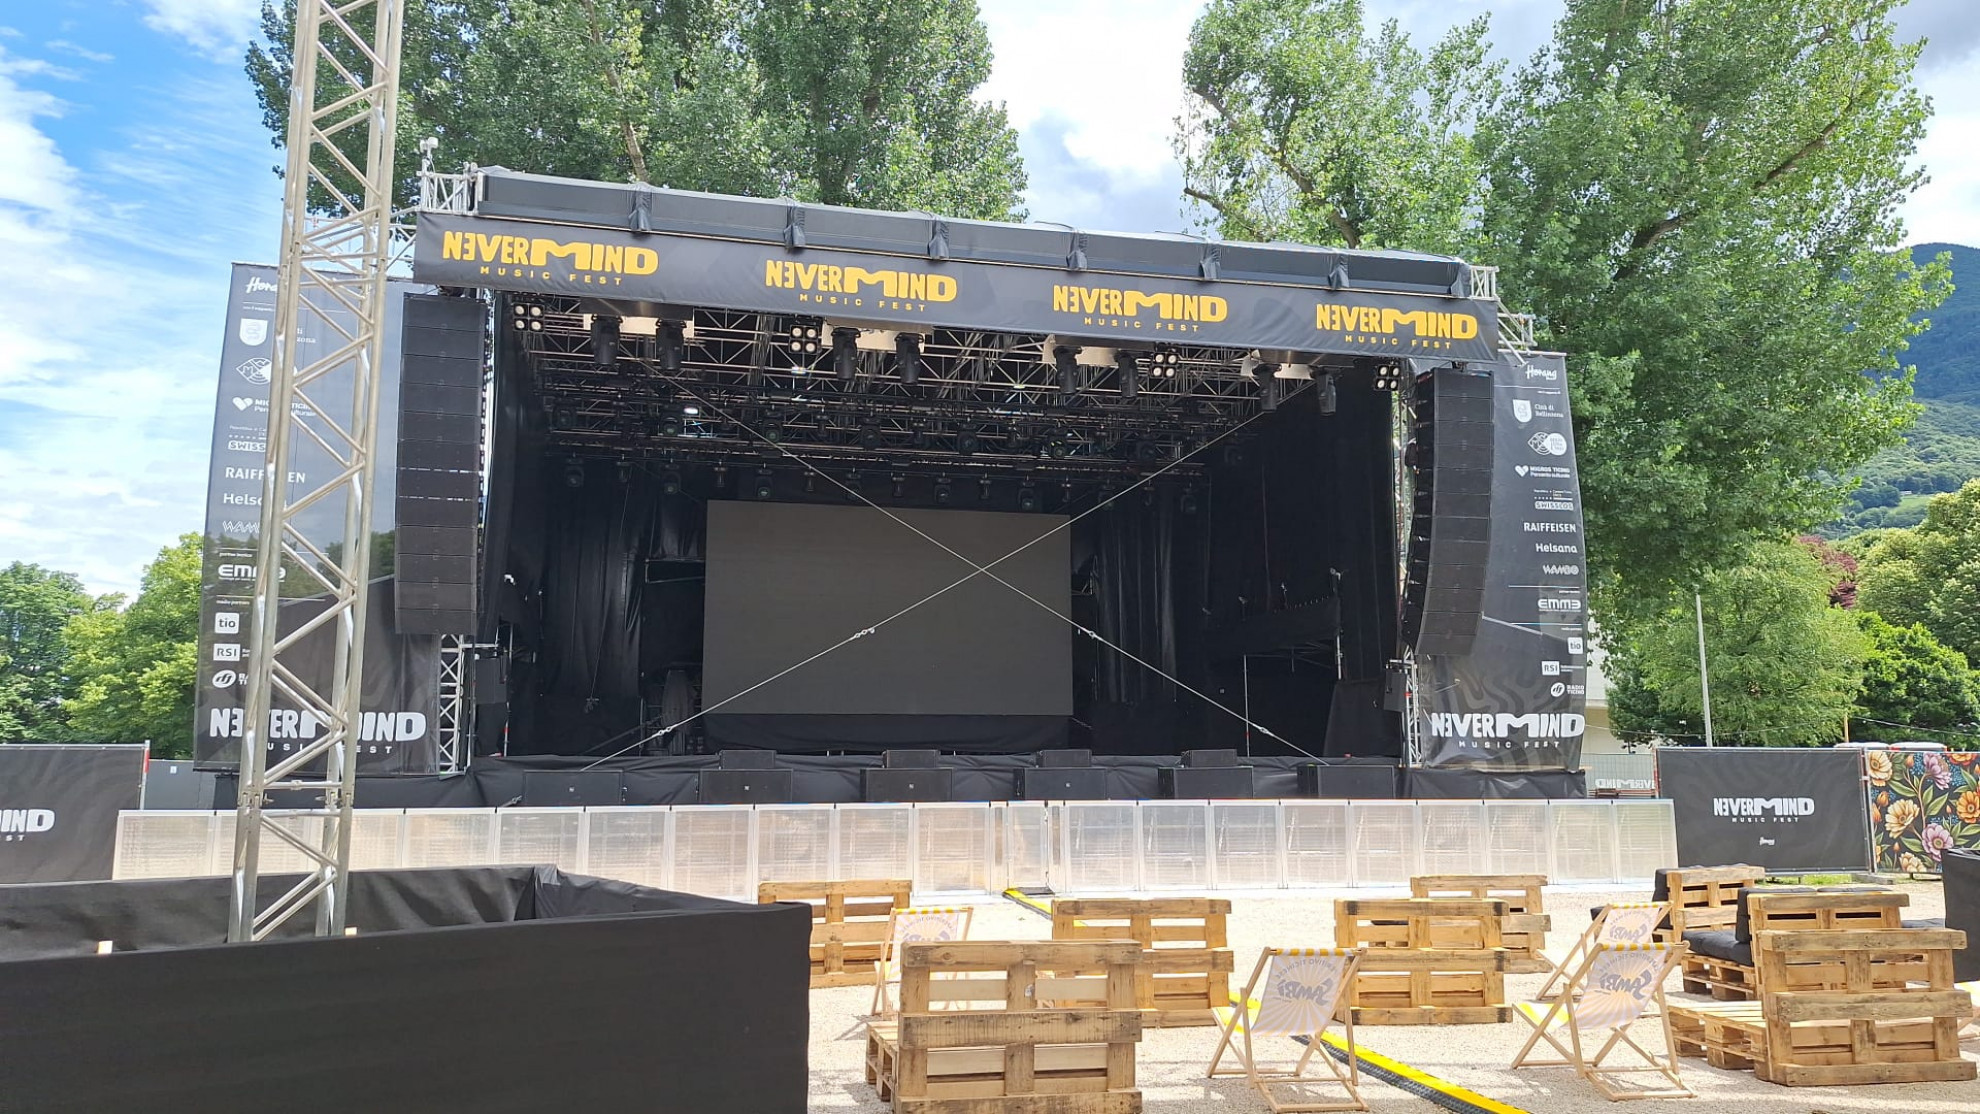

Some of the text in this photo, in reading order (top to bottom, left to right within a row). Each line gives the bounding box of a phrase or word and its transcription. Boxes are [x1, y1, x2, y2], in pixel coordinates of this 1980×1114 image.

[443, 231, 659, 276] NEVERMIND
[480, 266, 622, 285] MUSIC FEST
[766, 261, 958, 302] NEVERMIND
[799, 294, 926, 312] MUSIC FEST
[1053, 285, 1228, 322] NEVERMIND
[1084, 317, 1199, 332] MUSIC FEST
[1316, 304, 1478, 340] NEVERMIND
[1345, 334, 1451, 349] MUSIC FEST
[225, 467, 306, 483] RAIFFEN
[1523, 522, 1577, 533] RAIFFEISEN
[1535, 543, 1578, 553] Helsana
[218, 618, 237, 628] tio
[216, 648, 238, 657] RSI
[1570, 642, 1582, 650] tio
[1544, 664, 1559, 672] RSI
[1431, 713, 1586, 738] NEVERMIND
[1713, 797, 1815, 816] NEVERMIND
